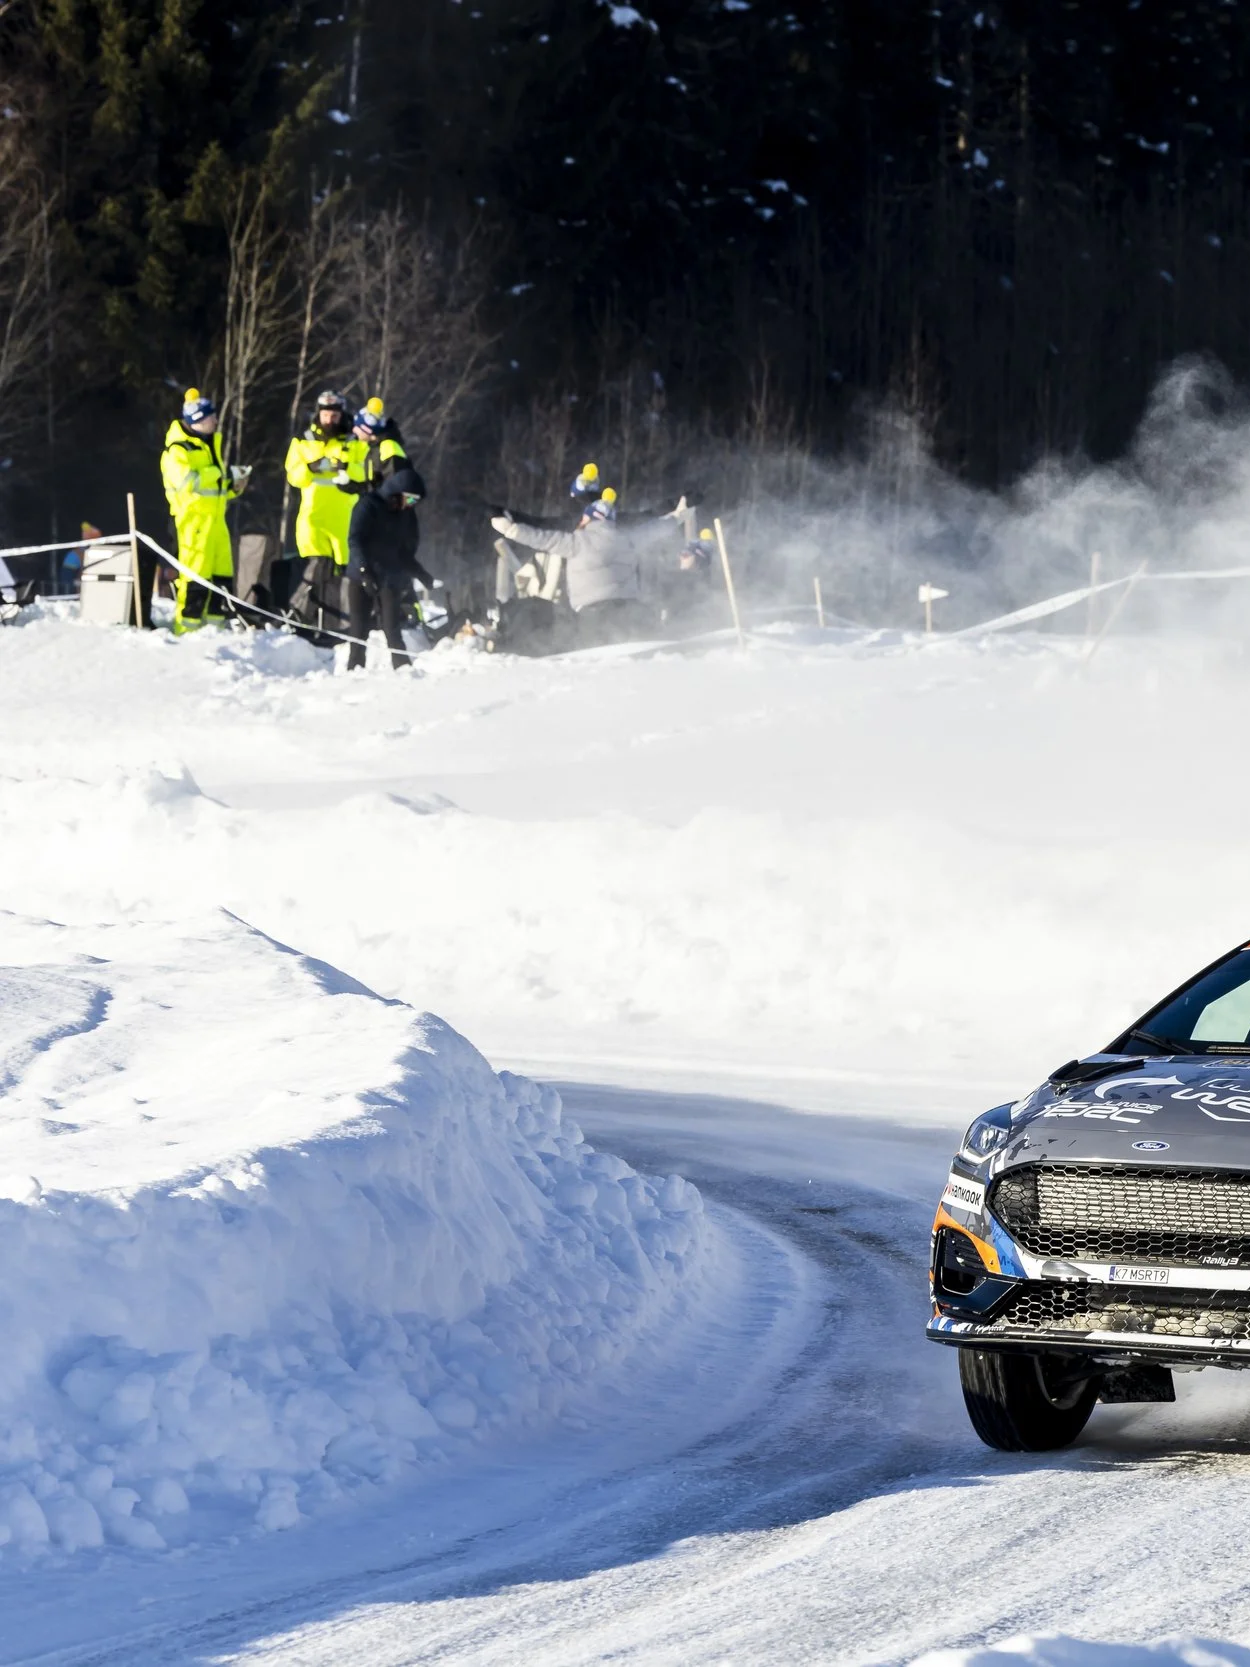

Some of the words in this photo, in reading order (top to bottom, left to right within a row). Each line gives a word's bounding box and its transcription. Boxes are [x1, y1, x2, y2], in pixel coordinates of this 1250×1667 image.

[1091, 1101, 1164, 1111] JUNIOR
[1202, 1256, 1240, 1267] Rally3
[1115, 1268, 1128, 1280] K7
[1130, 1269, 1167, 1281] MSRT9
